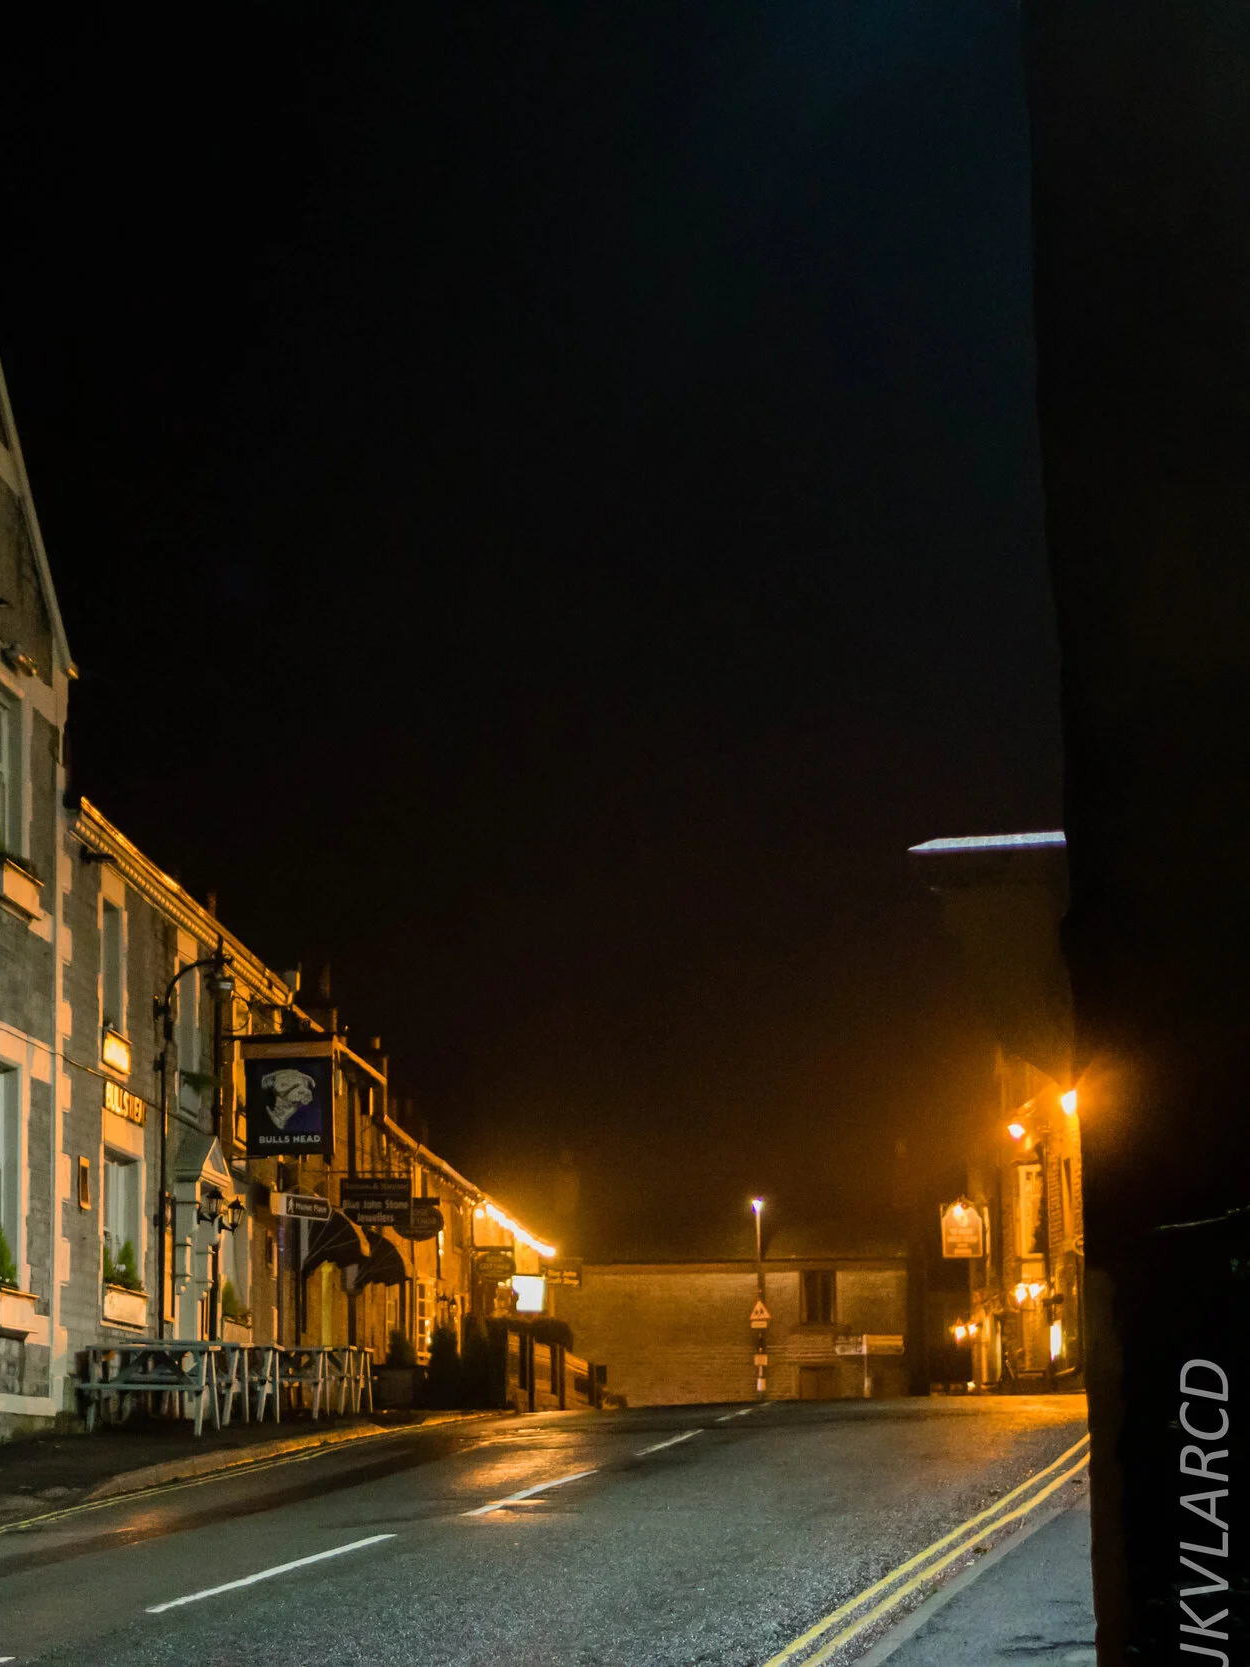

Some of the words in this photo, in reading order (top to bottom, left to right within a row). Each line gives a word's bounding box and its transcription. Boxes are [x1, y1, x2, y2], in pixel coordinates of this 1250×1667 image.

[258, 1135, 290, 1144] BULLS
[293, 1134, 321, 1143] HEAD
[363, 1199, 382, 1209] John
[385, 1198, 409, 1209] Stone
[357, 1211, 395, 1223] Jewellers
